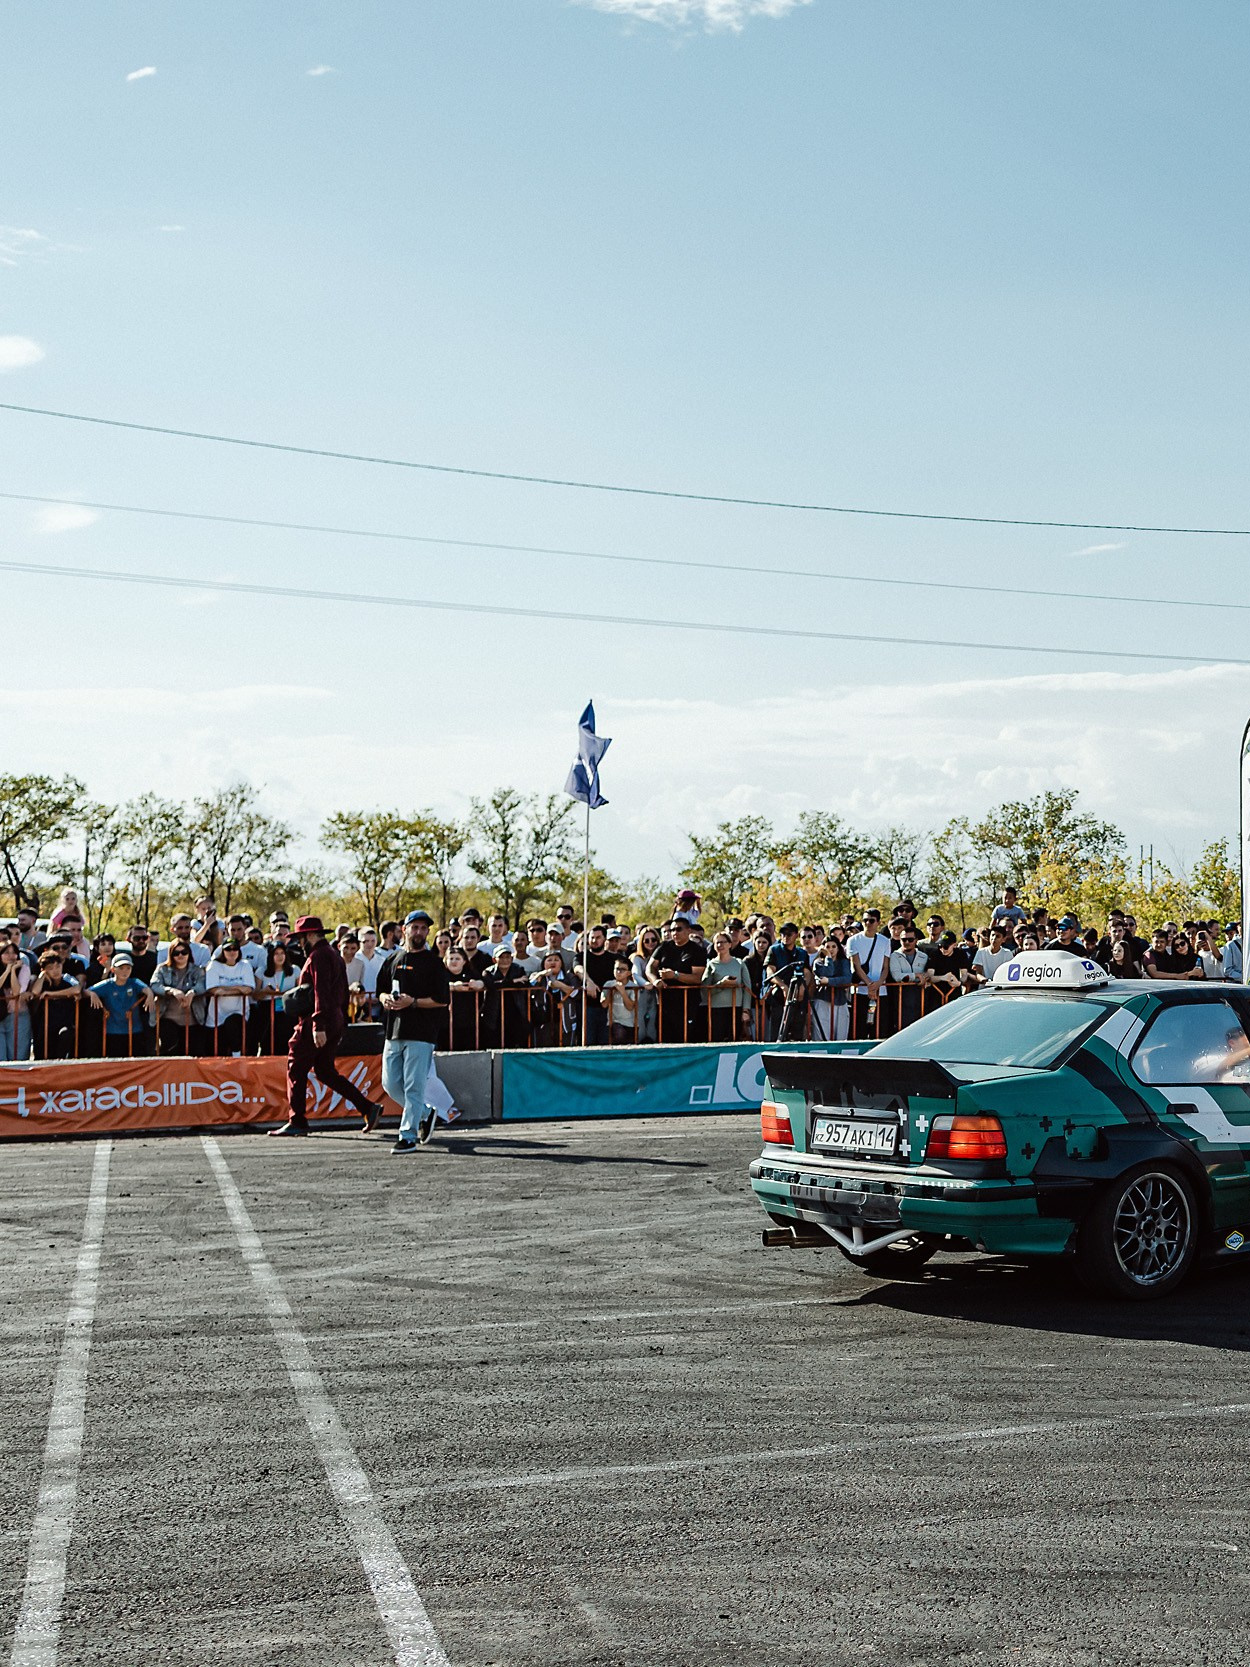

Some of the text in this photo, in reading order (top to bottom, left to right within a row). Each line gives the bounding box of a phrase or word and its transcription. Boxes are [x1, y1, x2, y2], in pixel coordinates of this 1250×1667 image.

[1022, 964, 1062, 982] region
[1084, 970, 1105, 981] region
[878, 1127, 894, 1148] 14
